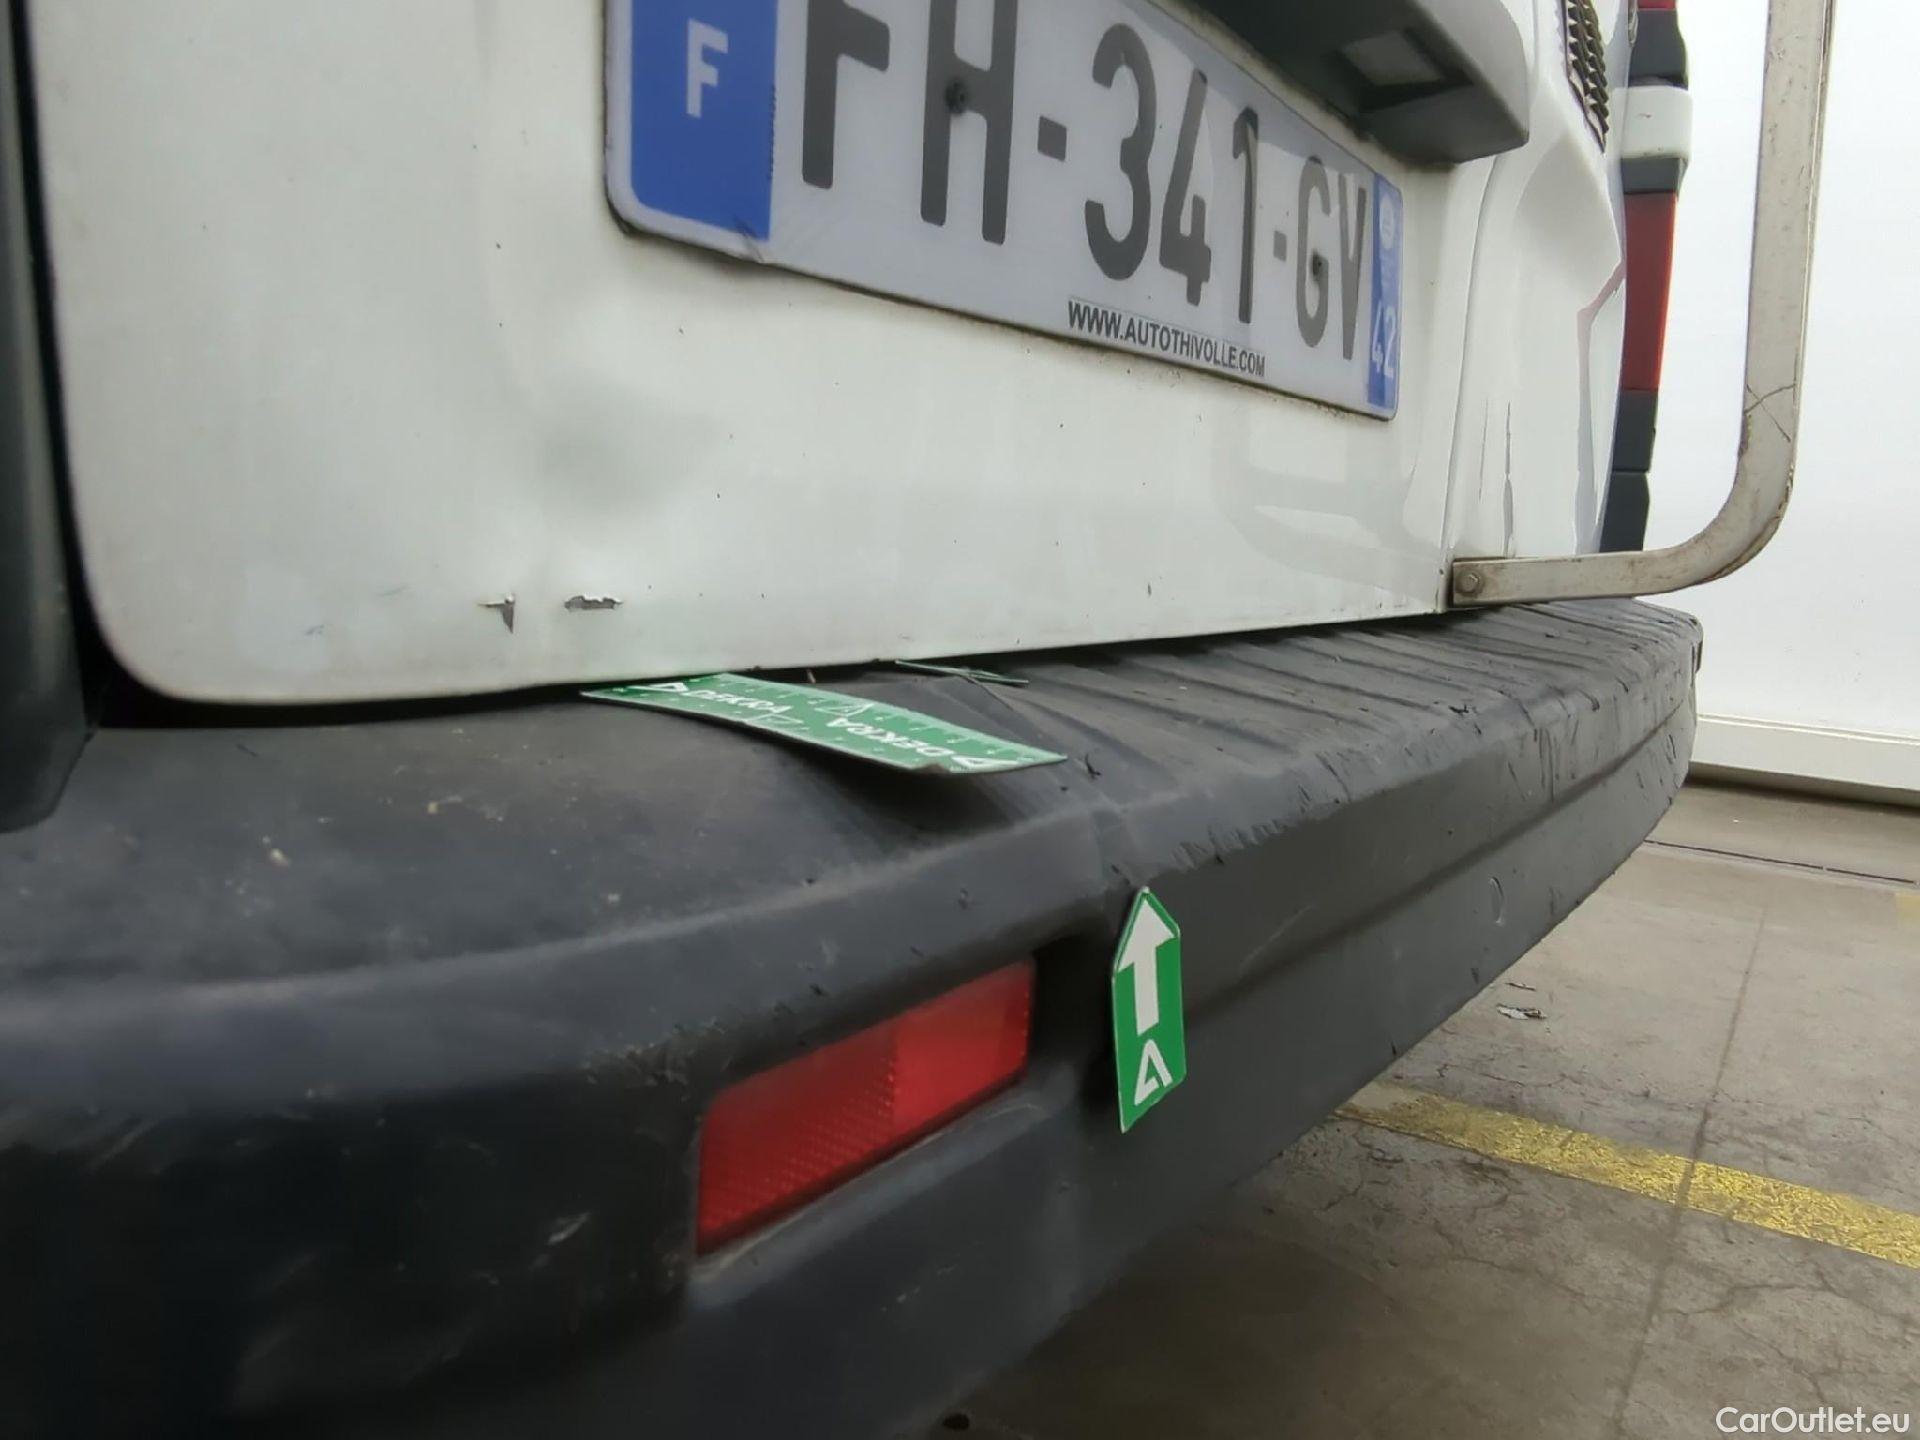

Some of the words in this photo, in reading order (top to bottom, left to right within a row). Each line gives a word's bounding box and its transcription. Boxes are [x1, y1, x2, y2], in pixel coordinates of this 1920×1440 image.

[687, 19, 729, 118] F
[1068, 300, 1265, 377] WWW.AUTOTHIVOLLE.COM
[1371, 300, 1397, 379] 42
[826, 717, 954, 757] DEKRA
